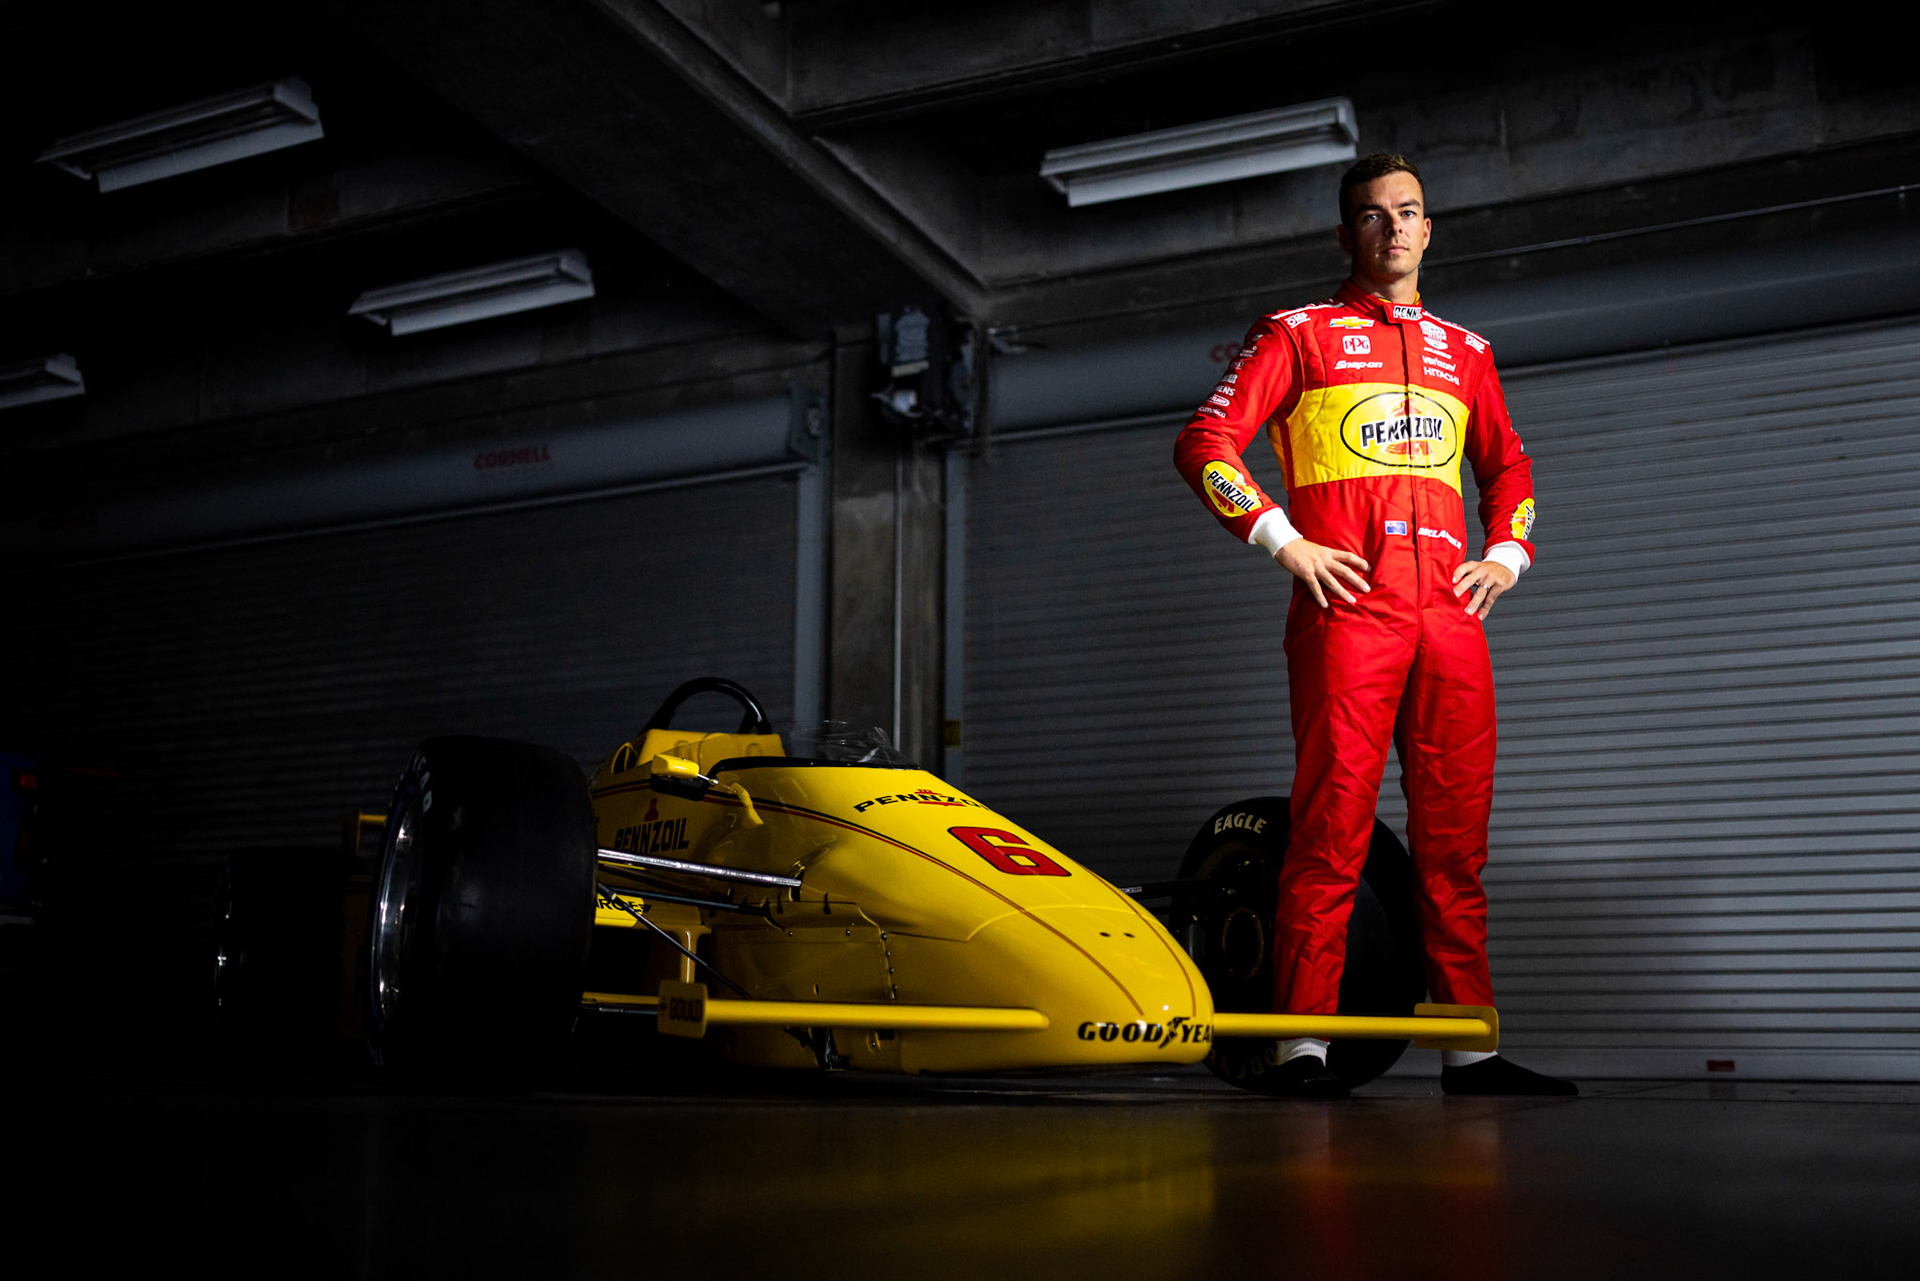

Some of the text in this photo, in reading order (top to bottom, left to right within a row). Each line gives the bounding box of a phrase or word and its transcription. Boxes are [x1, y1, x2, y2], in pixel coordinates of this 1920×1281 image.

[1344, 337, 1369, 352] PPG
[1334, 360, 1383, 370] Snap-on
[1423, 366, 1460, 386] HITACHI
[1361, 417, 1443, 447] PENNZOIL
[474, 444, 550, 470] CORNELL
[1206, 470, 1255, 513] PENNZOIL
[1214, 811, 1268, 835] EAGLE
[614, 818, 690, 855] PENNZOIL
[947, 826, 1072, 876] 6
